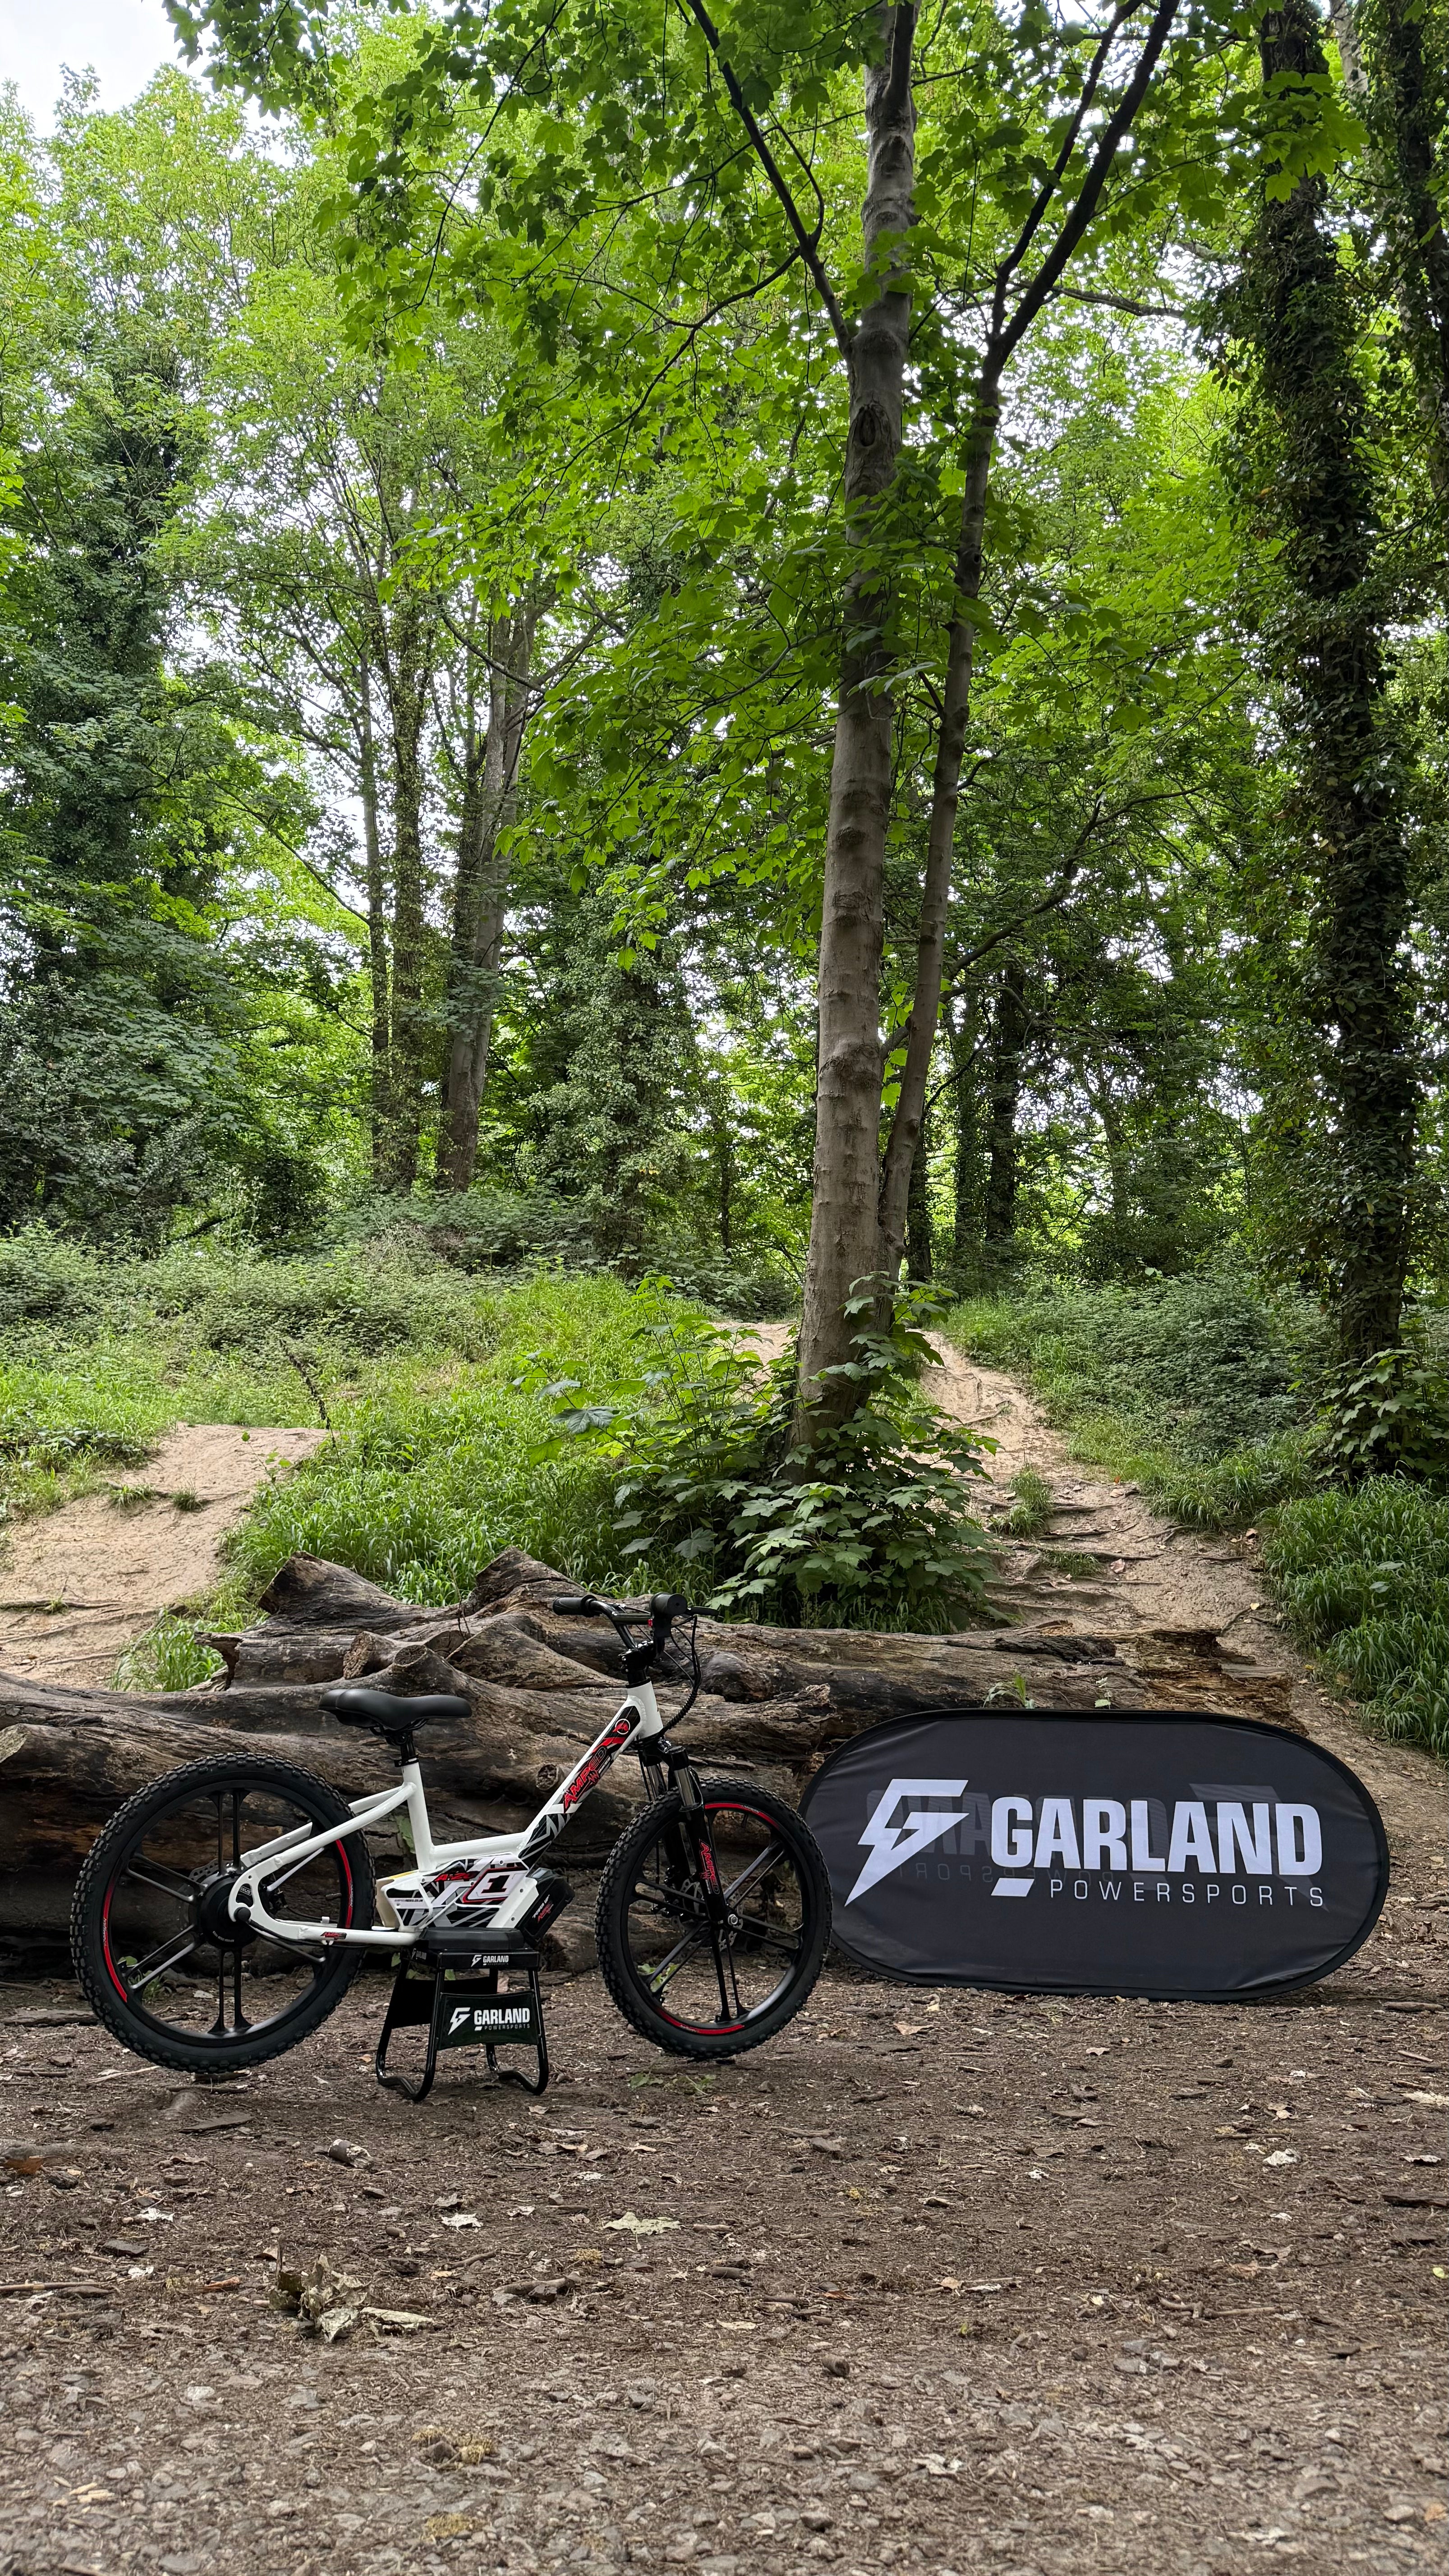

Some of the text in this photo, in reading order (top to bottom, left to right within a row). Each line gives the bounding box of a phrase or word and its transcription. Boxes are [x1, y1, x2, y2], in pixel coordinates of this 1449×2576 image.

[563, 1746, 607, 1810] AMPED
[991, 1797, 1323, 1875] GARLAND
[481, 1875, 510, 1893] 1
[1050, 1879, 1323, 1907] POWERSPORTS
[474, 2008, 530, 2025] GARLAND
